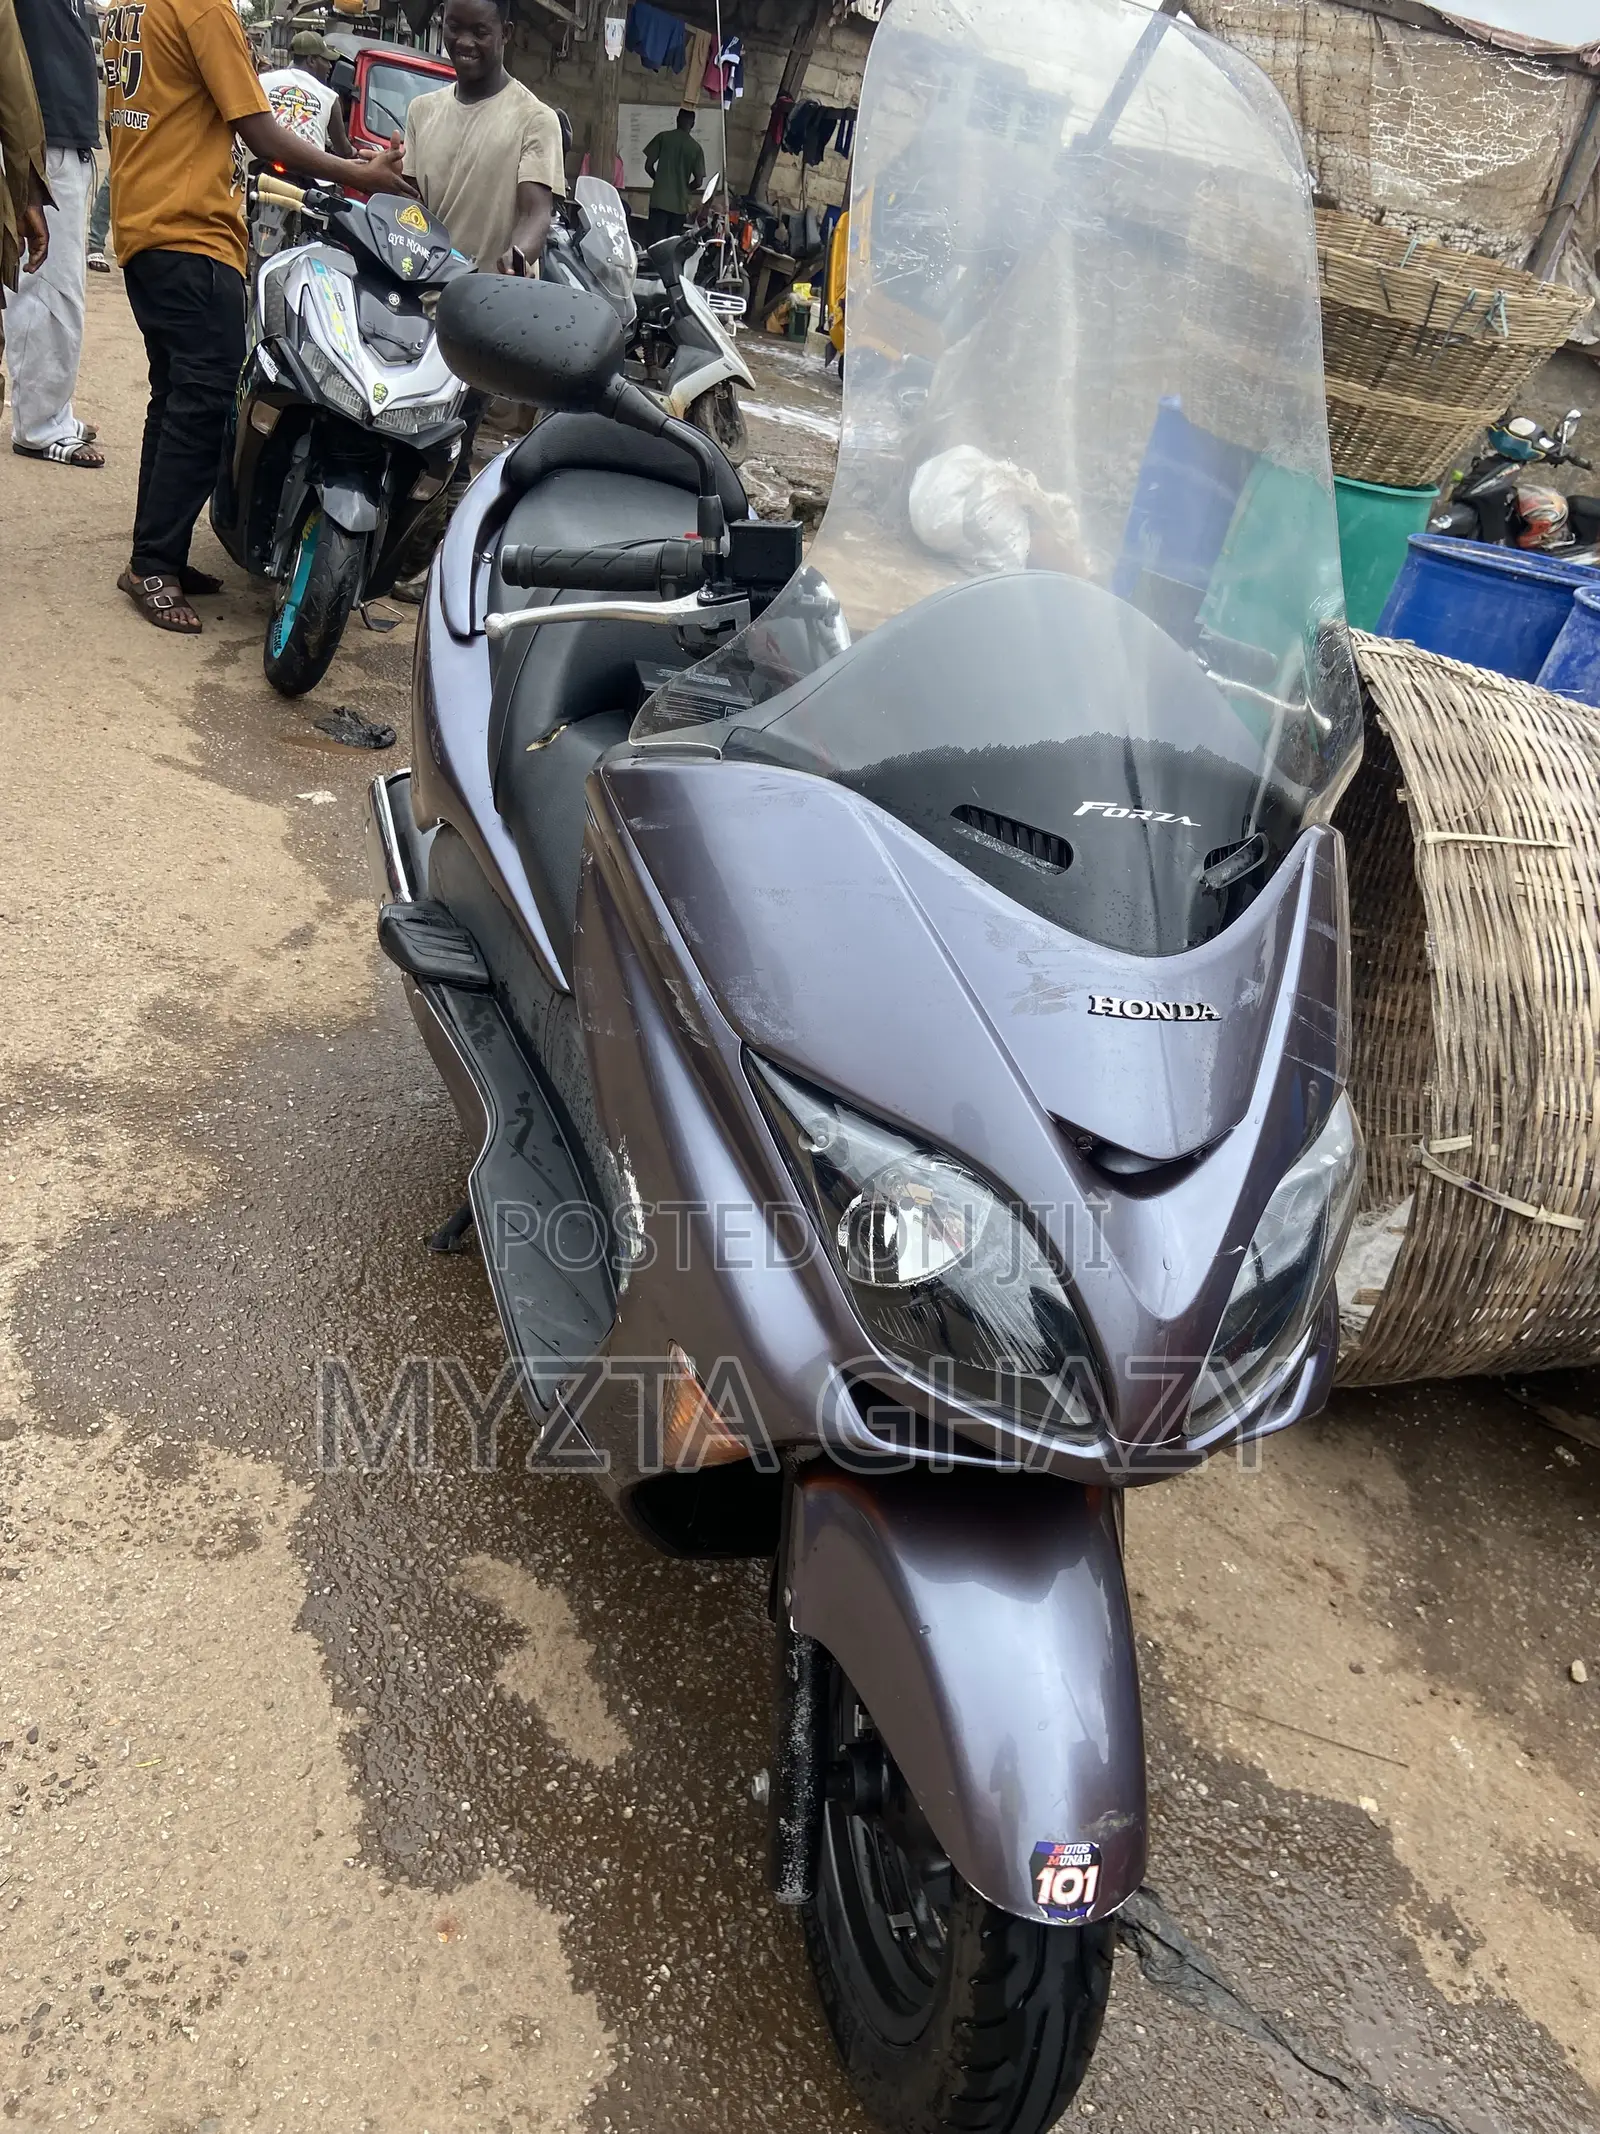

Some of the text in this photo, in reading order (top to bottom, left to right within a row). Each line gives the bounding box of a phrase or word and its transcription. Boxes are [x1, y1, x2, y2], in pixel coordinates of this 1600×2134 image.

[1073, 801, 1201, 826] FORZA
[1088, 995, 1222, 1022] HONDA
[1035, 1864, 1100, 1905] 101
